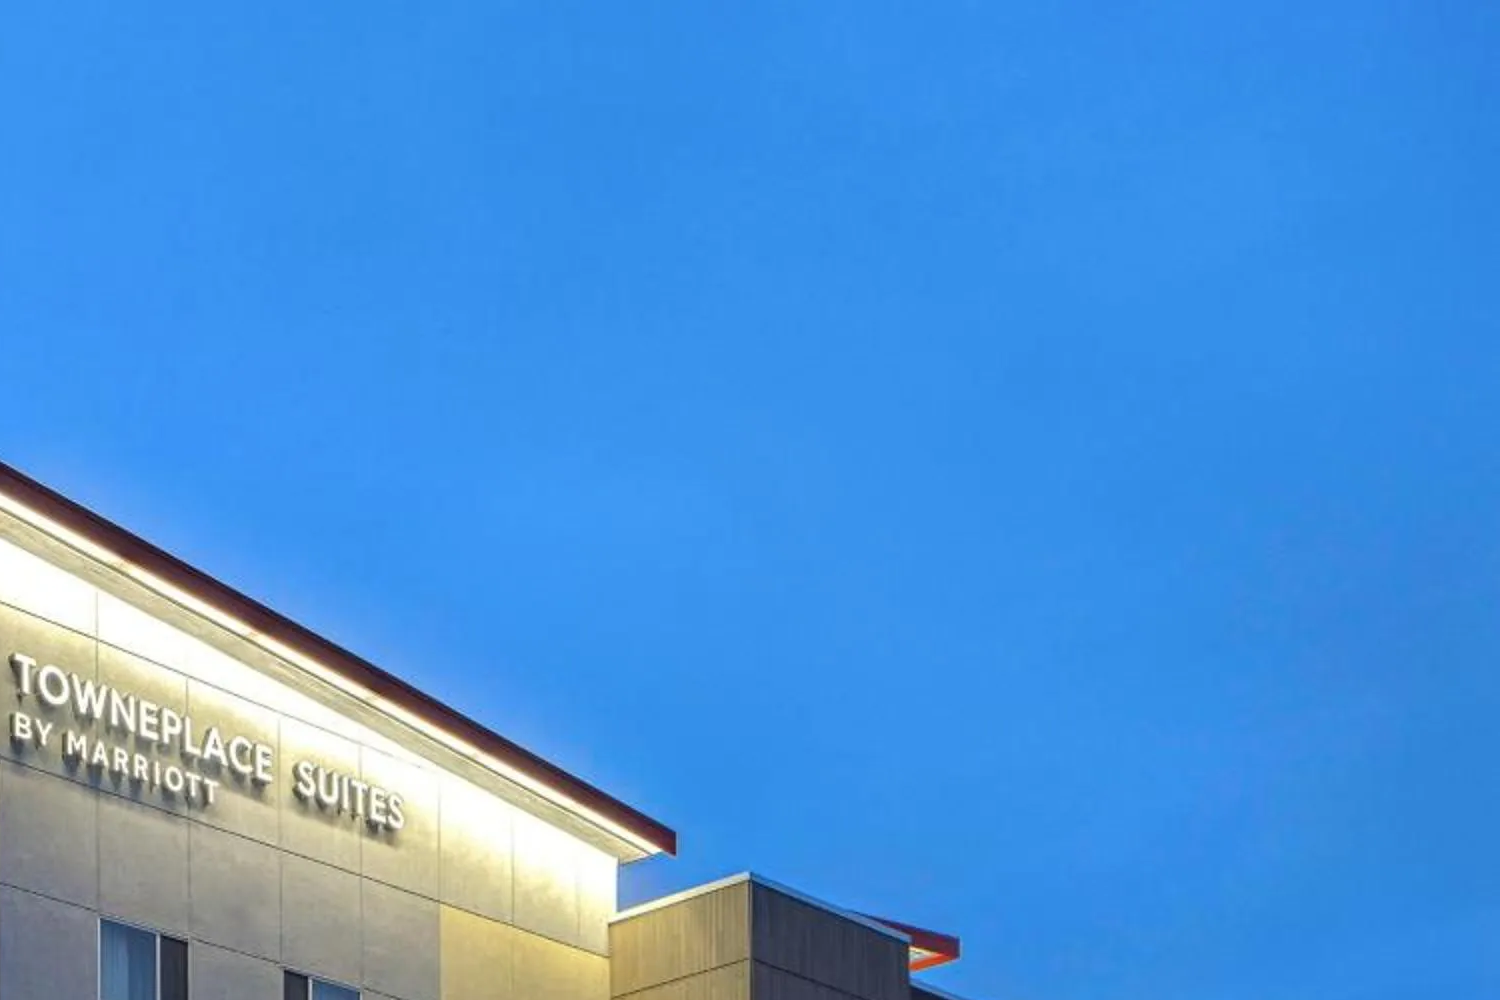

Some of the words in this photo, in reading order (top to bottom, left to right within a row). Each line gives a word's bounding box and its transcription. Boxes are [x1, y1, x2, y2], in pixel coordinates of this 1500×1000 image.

[11, 653, 274, 783] TOWNEPLACE
[296, 760, 406, 830] SUITES
[13, 710, 54, 746] BY
[66, 729, 220, 804] MARRIOTT
